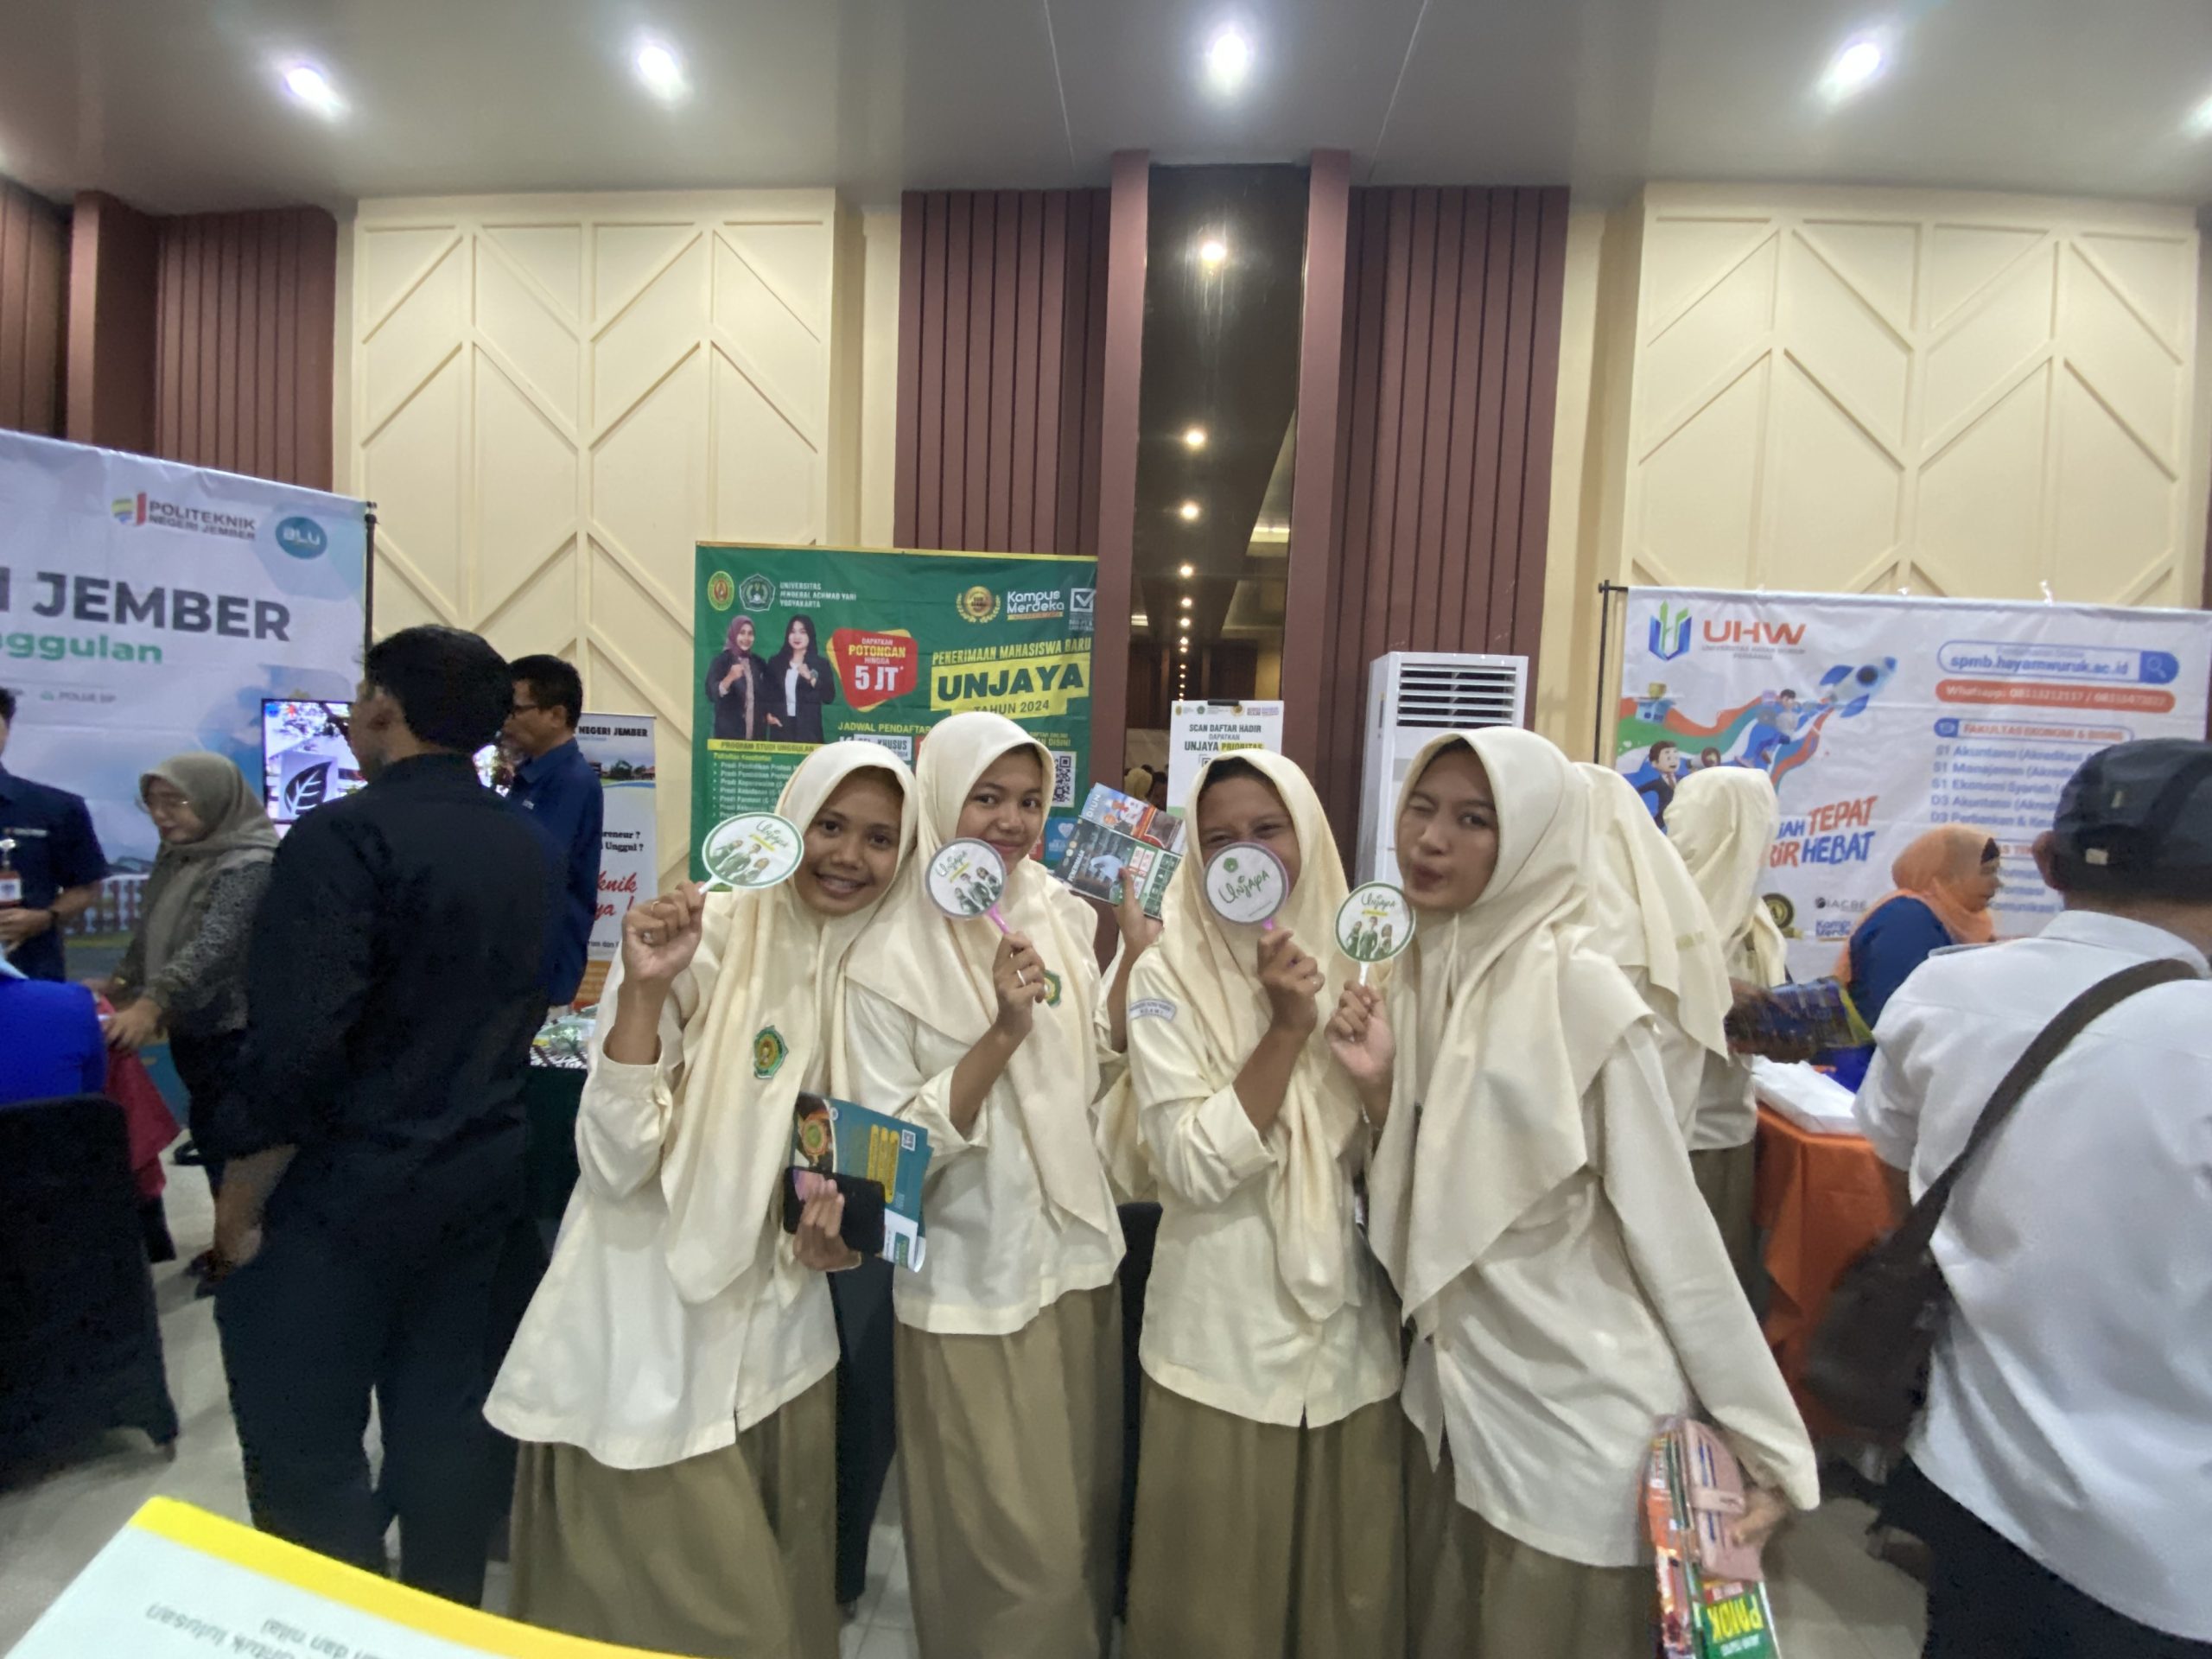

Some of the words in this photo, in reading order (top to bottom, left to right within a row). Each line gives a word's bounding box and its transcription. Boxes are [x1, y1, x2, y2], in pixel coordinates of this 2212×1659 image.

[149, 500, 255, 530] POLITEKNIK
[149, 514, 199, 532] NEGERI
[202, 524, 256, 541] JEMBER
[780, 582, 821, 590] UNIVERSITAS
[780, 600, 821, 608] YOGYAKARTA
[1007, 590, 1061, 604] Kampus
[32, 570, 290, 642] JEMBER
[1007, 601, 1065, 613] Merdeka
[1703, 620, 1806, 645] UHW
[0, 632, 162, 664] ggulan
[849, 645, 906, 658] POTONGAN
[932, 647, 996, 665] PENERIMAAN
[1000, 639, 1062, 659] MAHASISWA
[1065, 637, 1091, 653] BARU
[855, 665, 870, 690] 5
[938, 663, 1084, 702] UNJAYA
[1020, 700, 1049, 713] 2024
[578, 726, 611, 736] NEGERI
[613, 727, 648, 737] JEMBER
[838, 721, 875, 732] JADWAL
[1189, 724, 1208, 733] SCAN
[1210, 724, 1237, 733] DAFTAR
[1239, 724, 1262, 733] HADIR
[878, 739, 907, 750] KHUSUS
[1185, 741, 1218, 751] UNJAYA
[1808, 795, 1878, 836] TEPAT
[1776, 819, 1805, 840] IAH
[606, 842, 637, 852] Unggul
[1802, 830, 1876, 865] HEBAT
